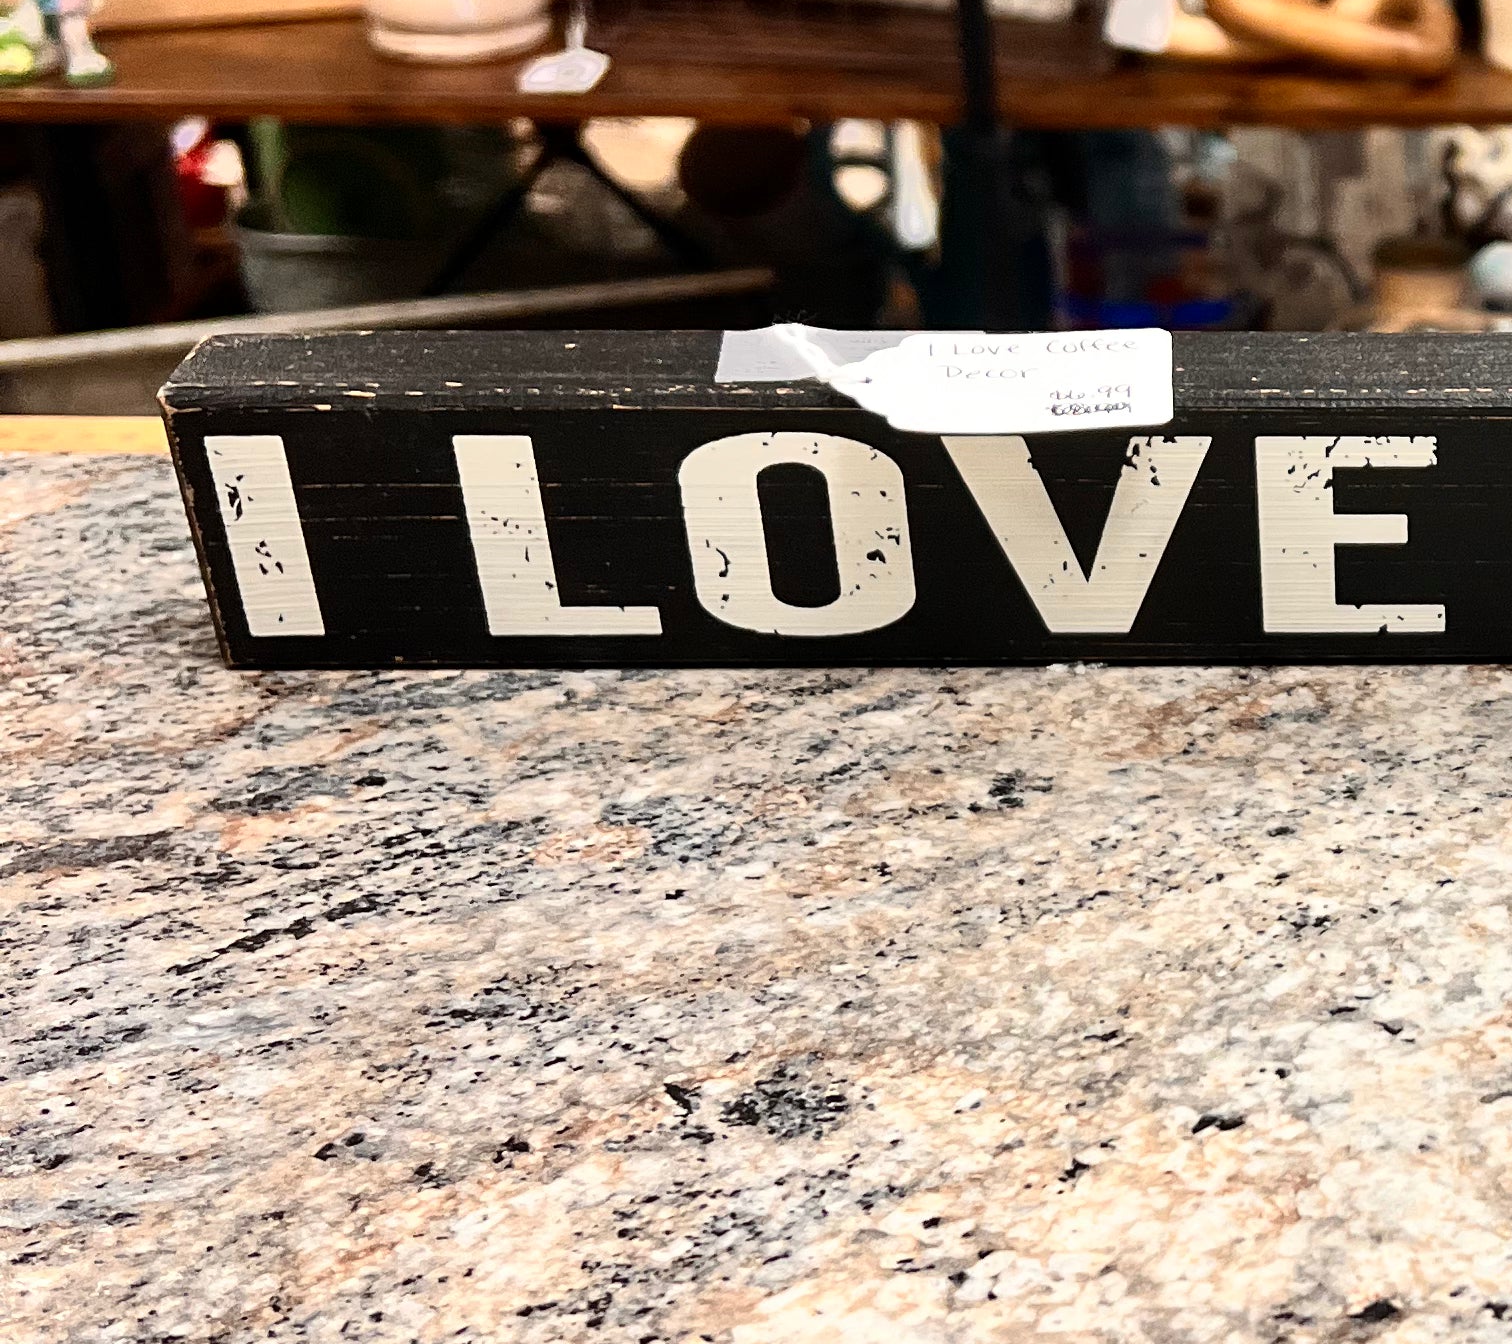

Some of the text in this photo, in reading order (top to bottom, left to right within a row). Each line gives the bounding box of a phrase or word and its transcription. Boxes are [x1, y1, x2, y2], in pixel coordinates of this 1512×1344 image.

[938, 364, 1039, 380] Decor
[203, 434, 326, 637] I
[451, 431, 1446, 637] LOVE
